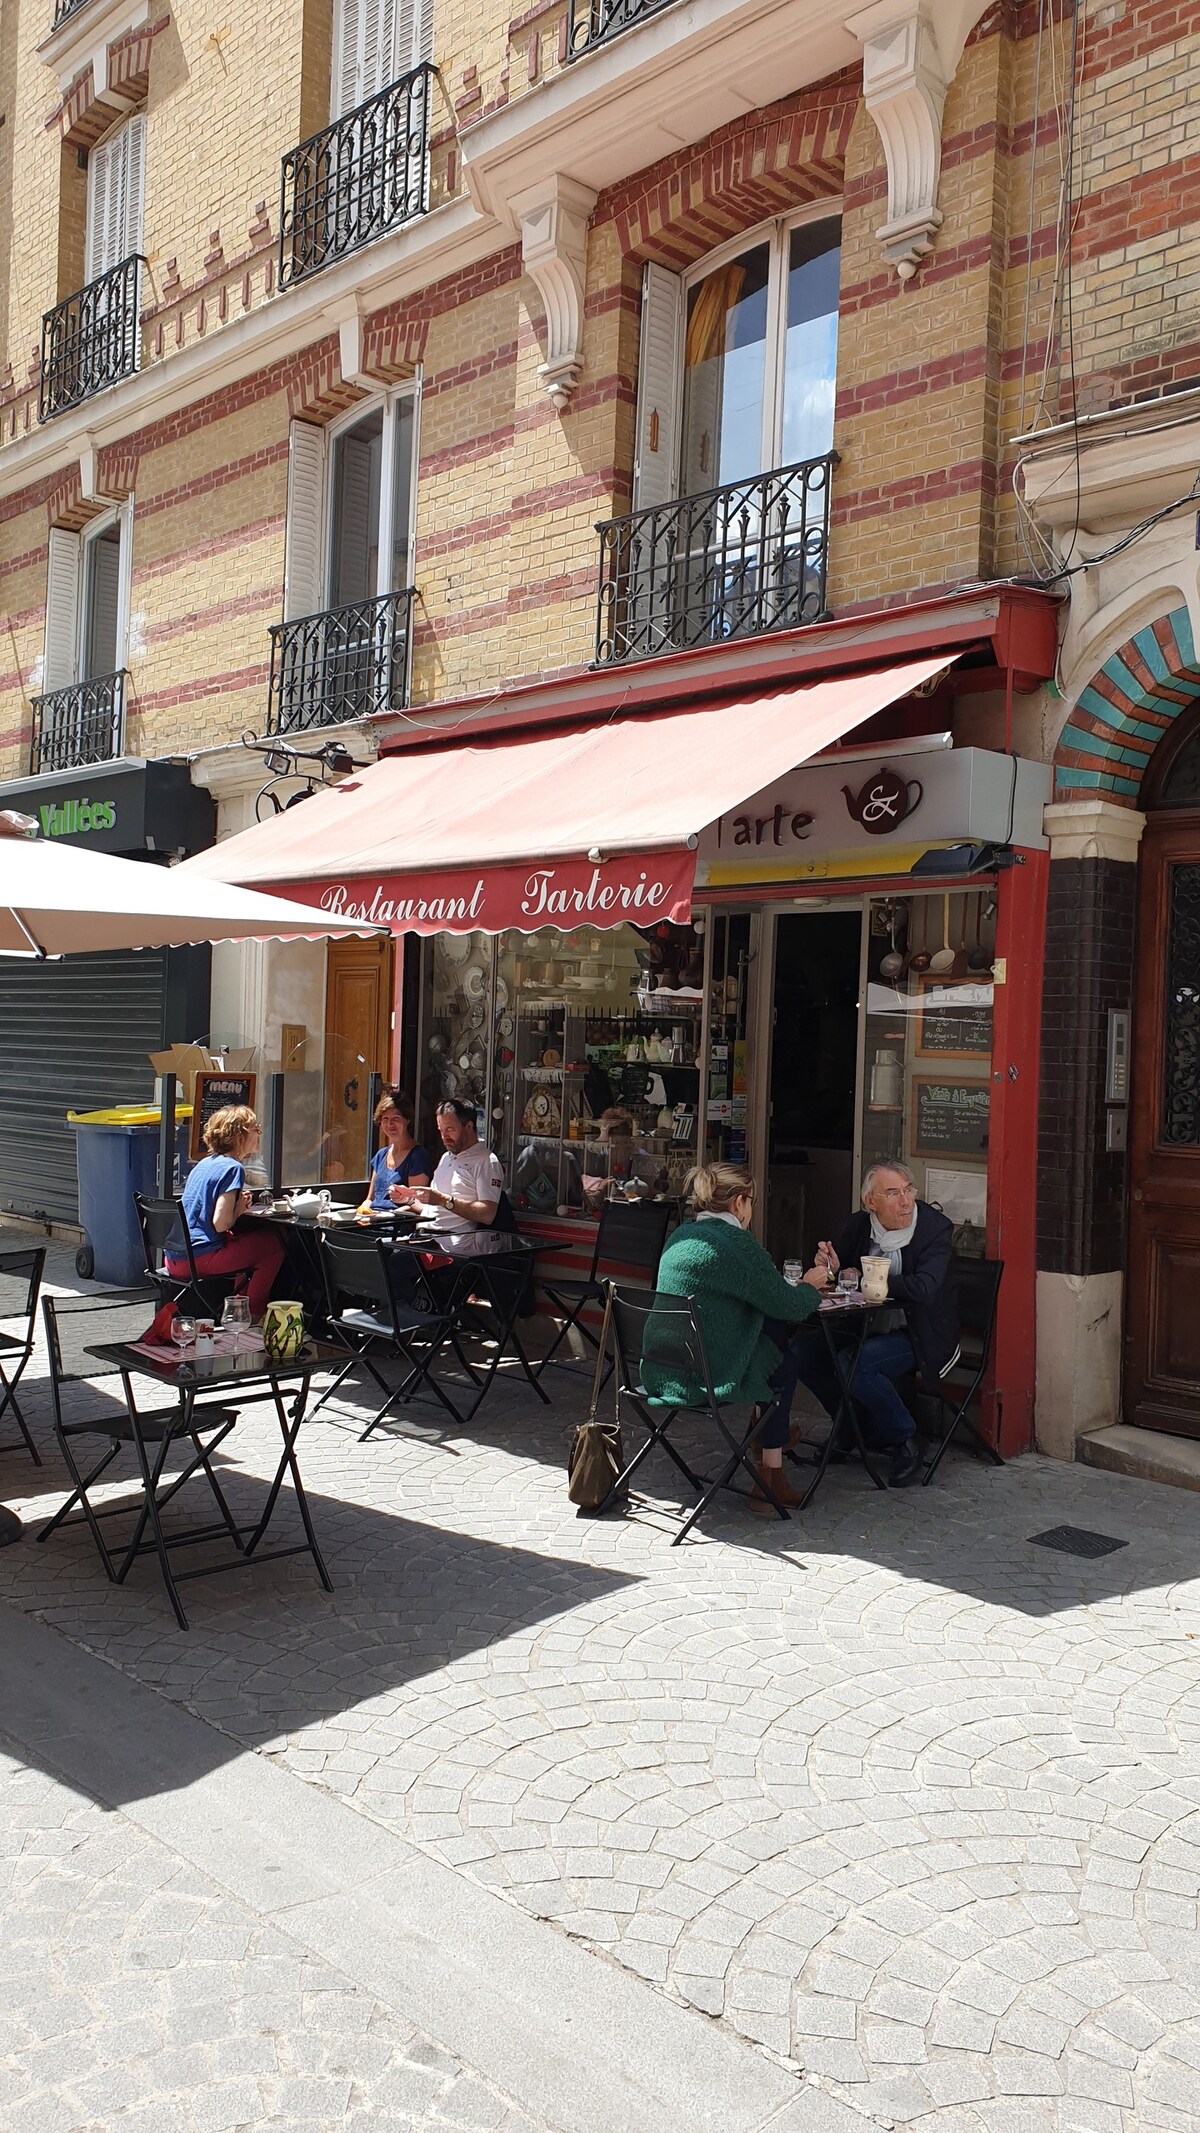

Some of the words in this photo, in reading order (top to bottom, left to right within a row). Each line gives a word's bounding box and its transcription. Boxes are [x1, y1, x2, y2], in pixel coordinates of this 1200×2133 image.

[40, 797, 117, 837] Vallées
[320, 880, 485, 922] Restaurant
[521, 868, 673, 917] Tarterie
